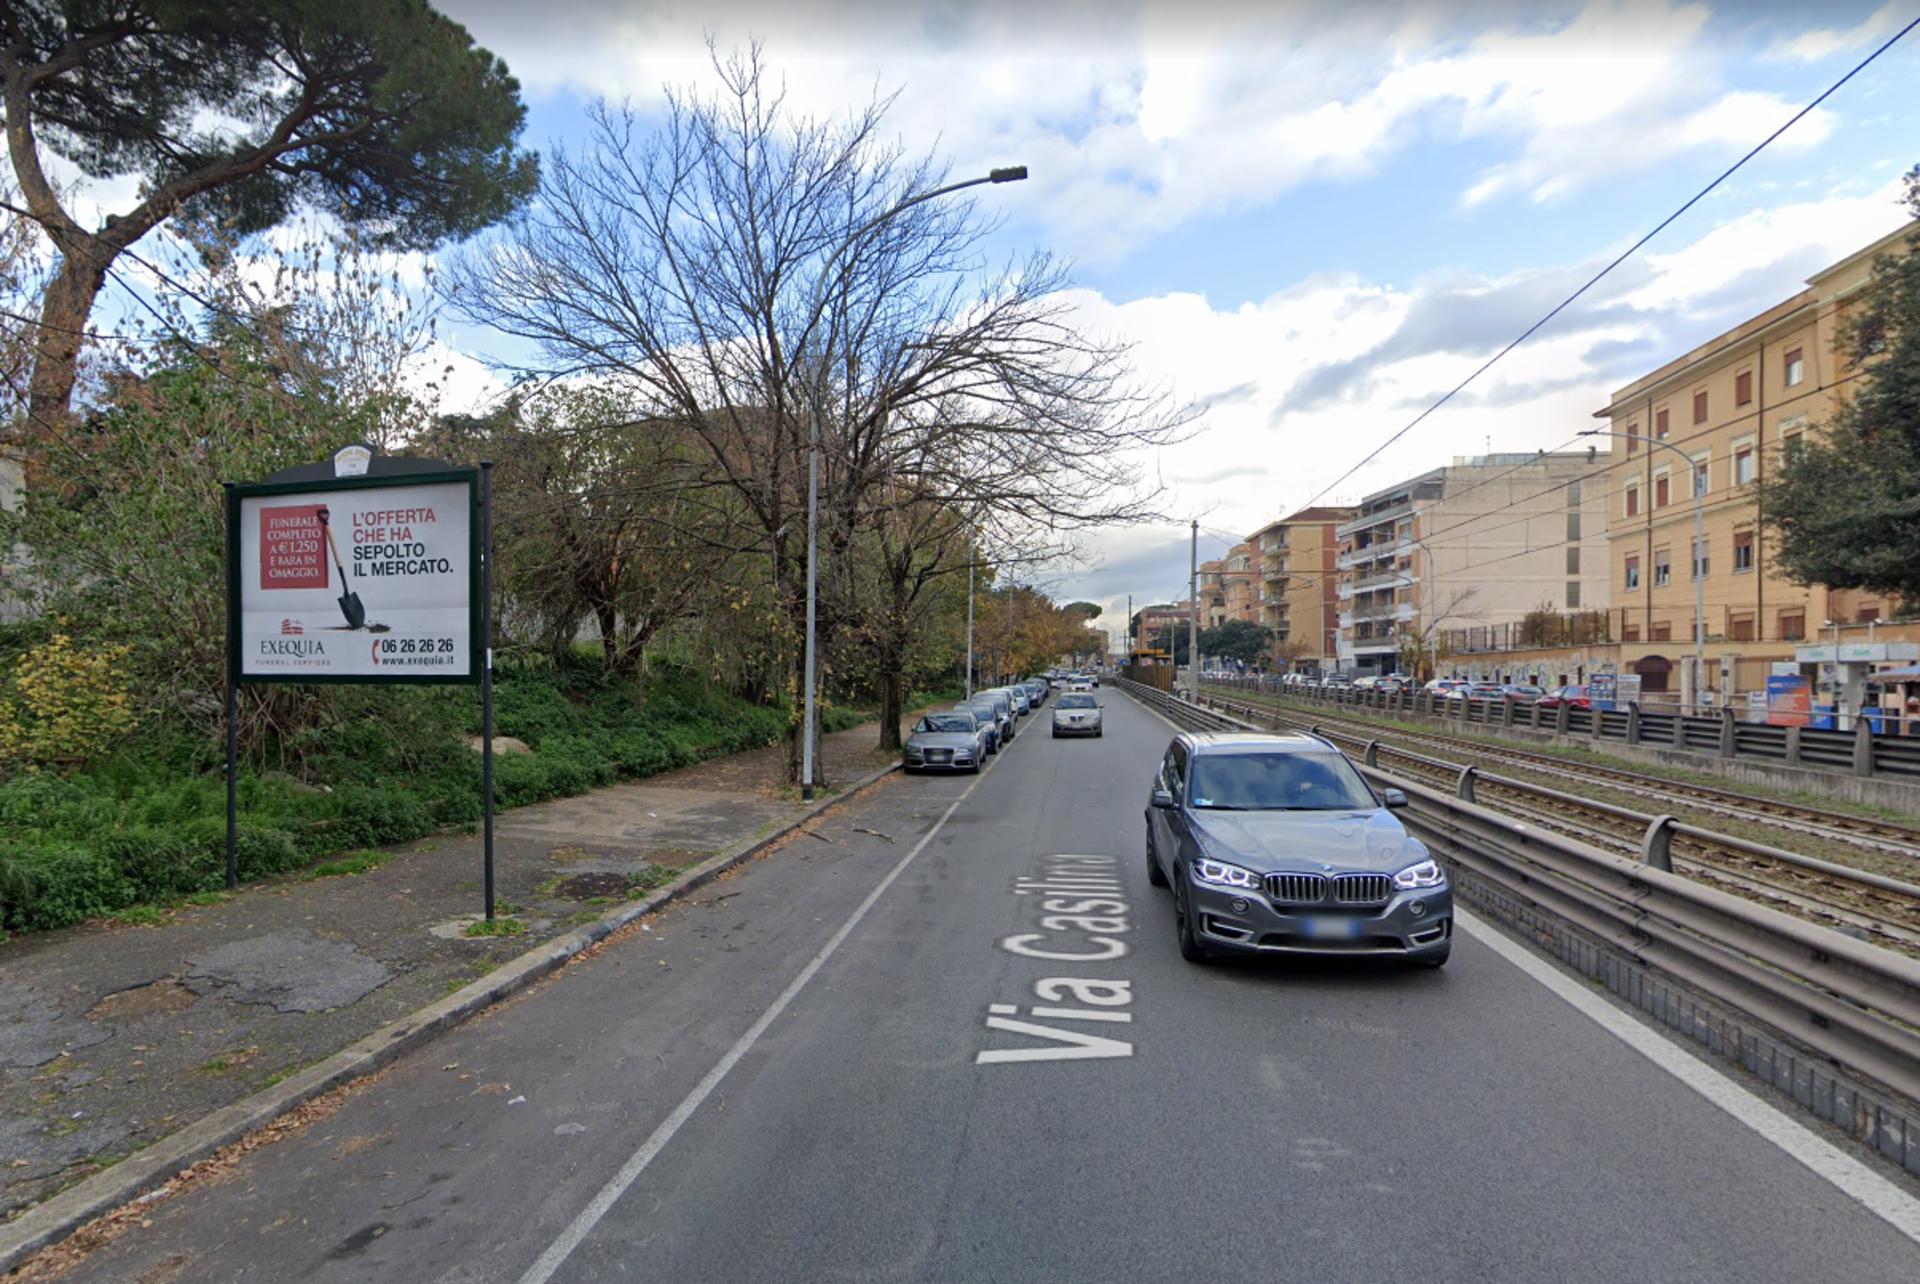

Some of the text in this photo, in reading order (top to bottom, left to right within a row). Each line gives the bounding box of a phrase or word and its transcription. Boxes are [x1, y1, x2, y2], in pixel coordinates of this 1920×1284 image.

[270, 516, 318, 528] FUNERALE
[353, 508, 436, 527] L'OFFERTA
[267, 528, 321, 540] COMPLETO
[353, 526, 413, 544] CHE HA
[270, 545, 278, 554] A
[353, 542, 426, 561] SEPOLTO
[305, 555, 317, 565] IN
[353, 558, 454, 577] IL MERCATO.
[261, 640, 325, 658] EXEQUIA
[382, 637, 454, 654] 06 26 26 26
